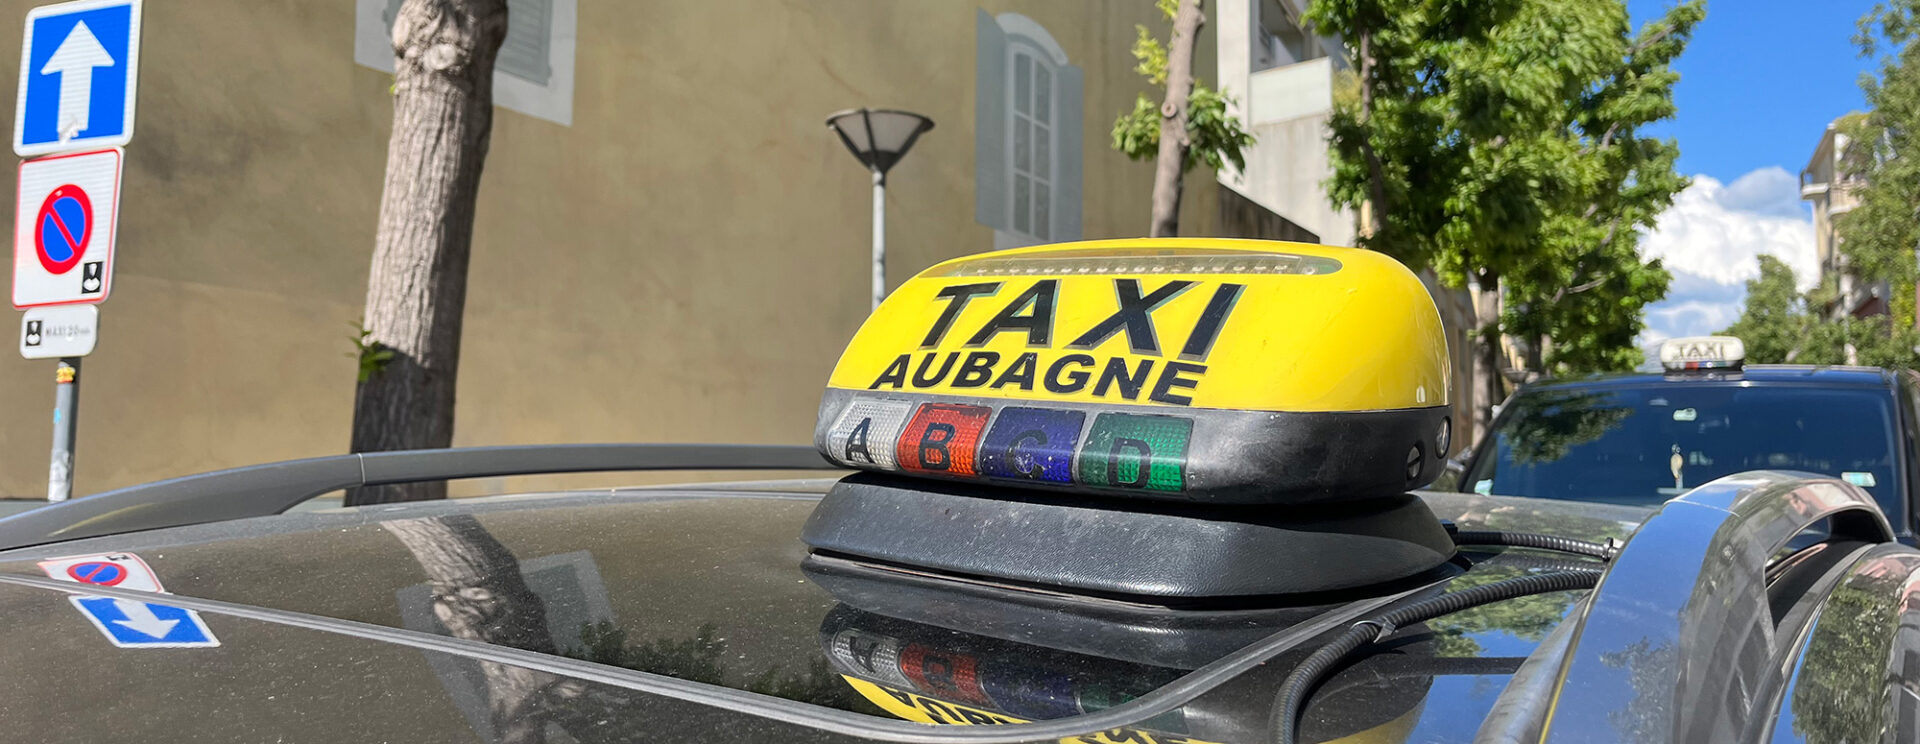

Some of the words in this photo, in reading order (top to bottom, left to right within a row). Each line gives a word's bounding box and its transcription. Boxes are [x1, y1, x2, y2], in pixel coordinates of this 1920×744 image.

[918, 279, 1248, 363] TAXI
[1674, 342, 1725, 358] TAXI
[867, 351, 1208, 406] AUBAGNE
[845, 417, 876, 464] A
[918, 422, 956, 471] B
[1005, 429, 1048, 480] C
[1107, 437, 1152, 489] D
